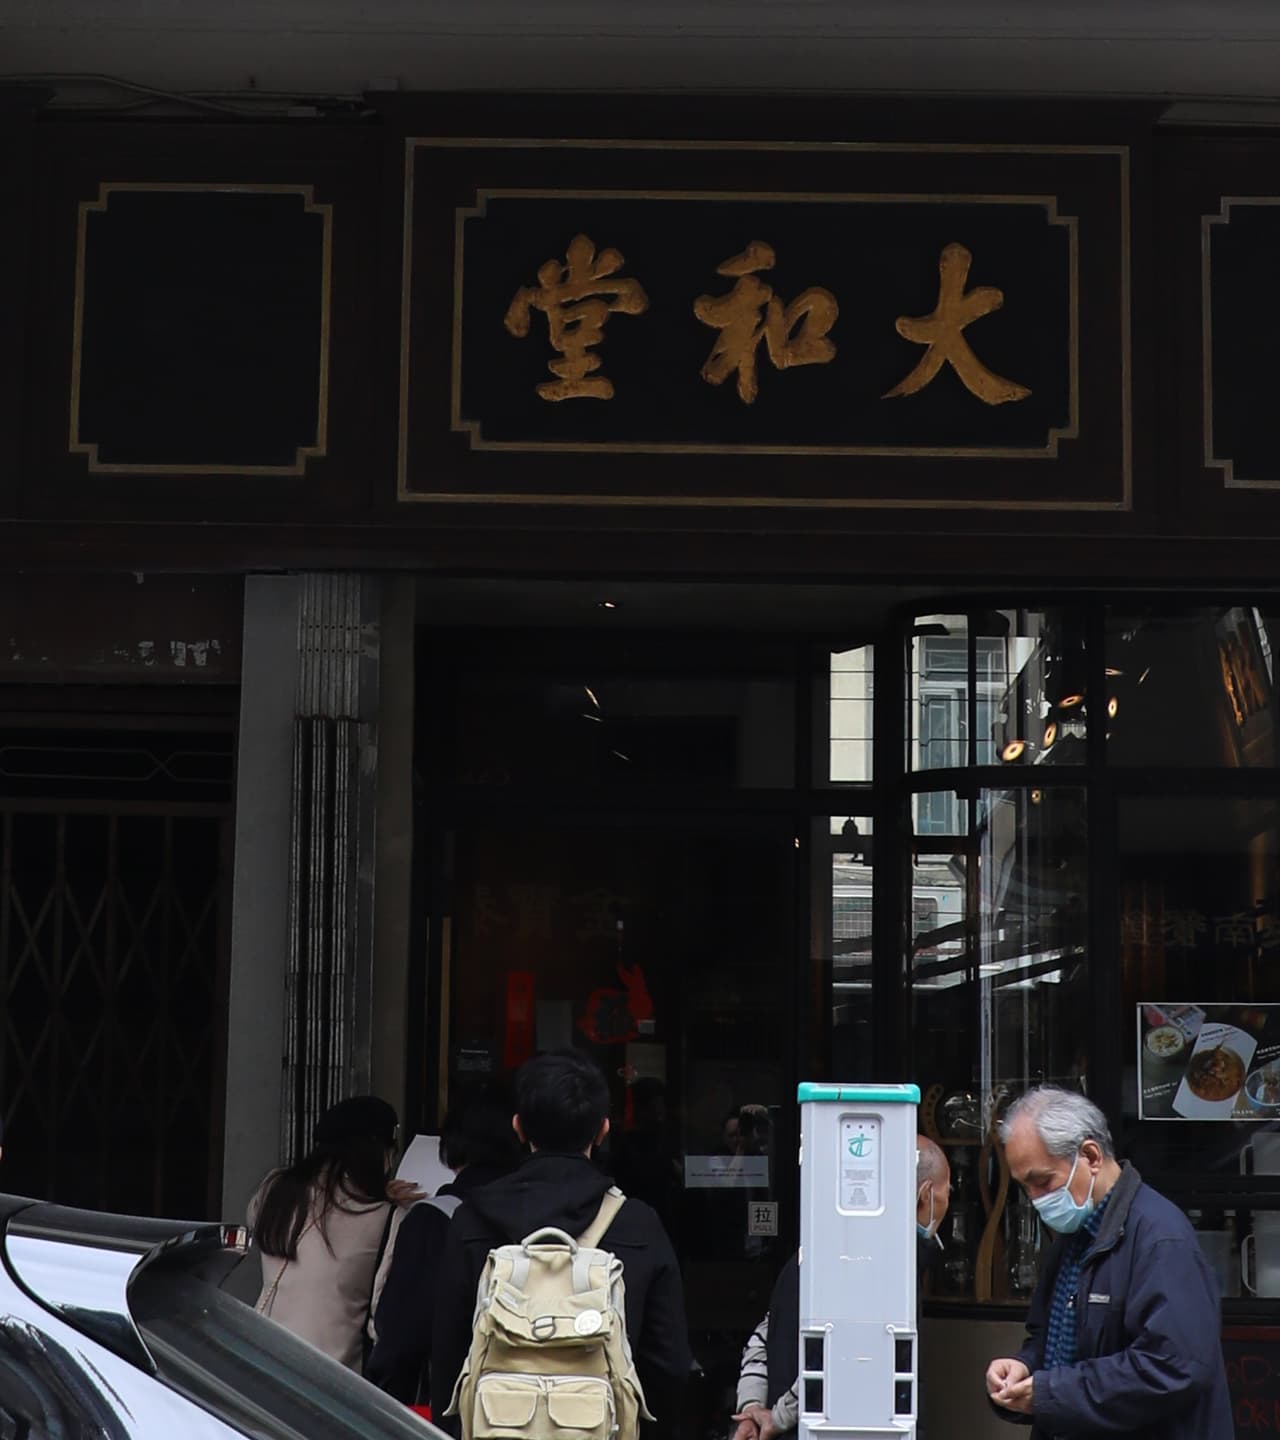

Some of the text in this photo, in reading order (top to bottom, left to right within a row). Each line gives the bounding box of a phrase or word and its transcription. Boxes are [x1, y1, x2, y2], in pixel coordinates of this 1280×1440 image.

[504, 233, 1033, 405] 大和堂
[754, 1207, 772, 1223] 拉
